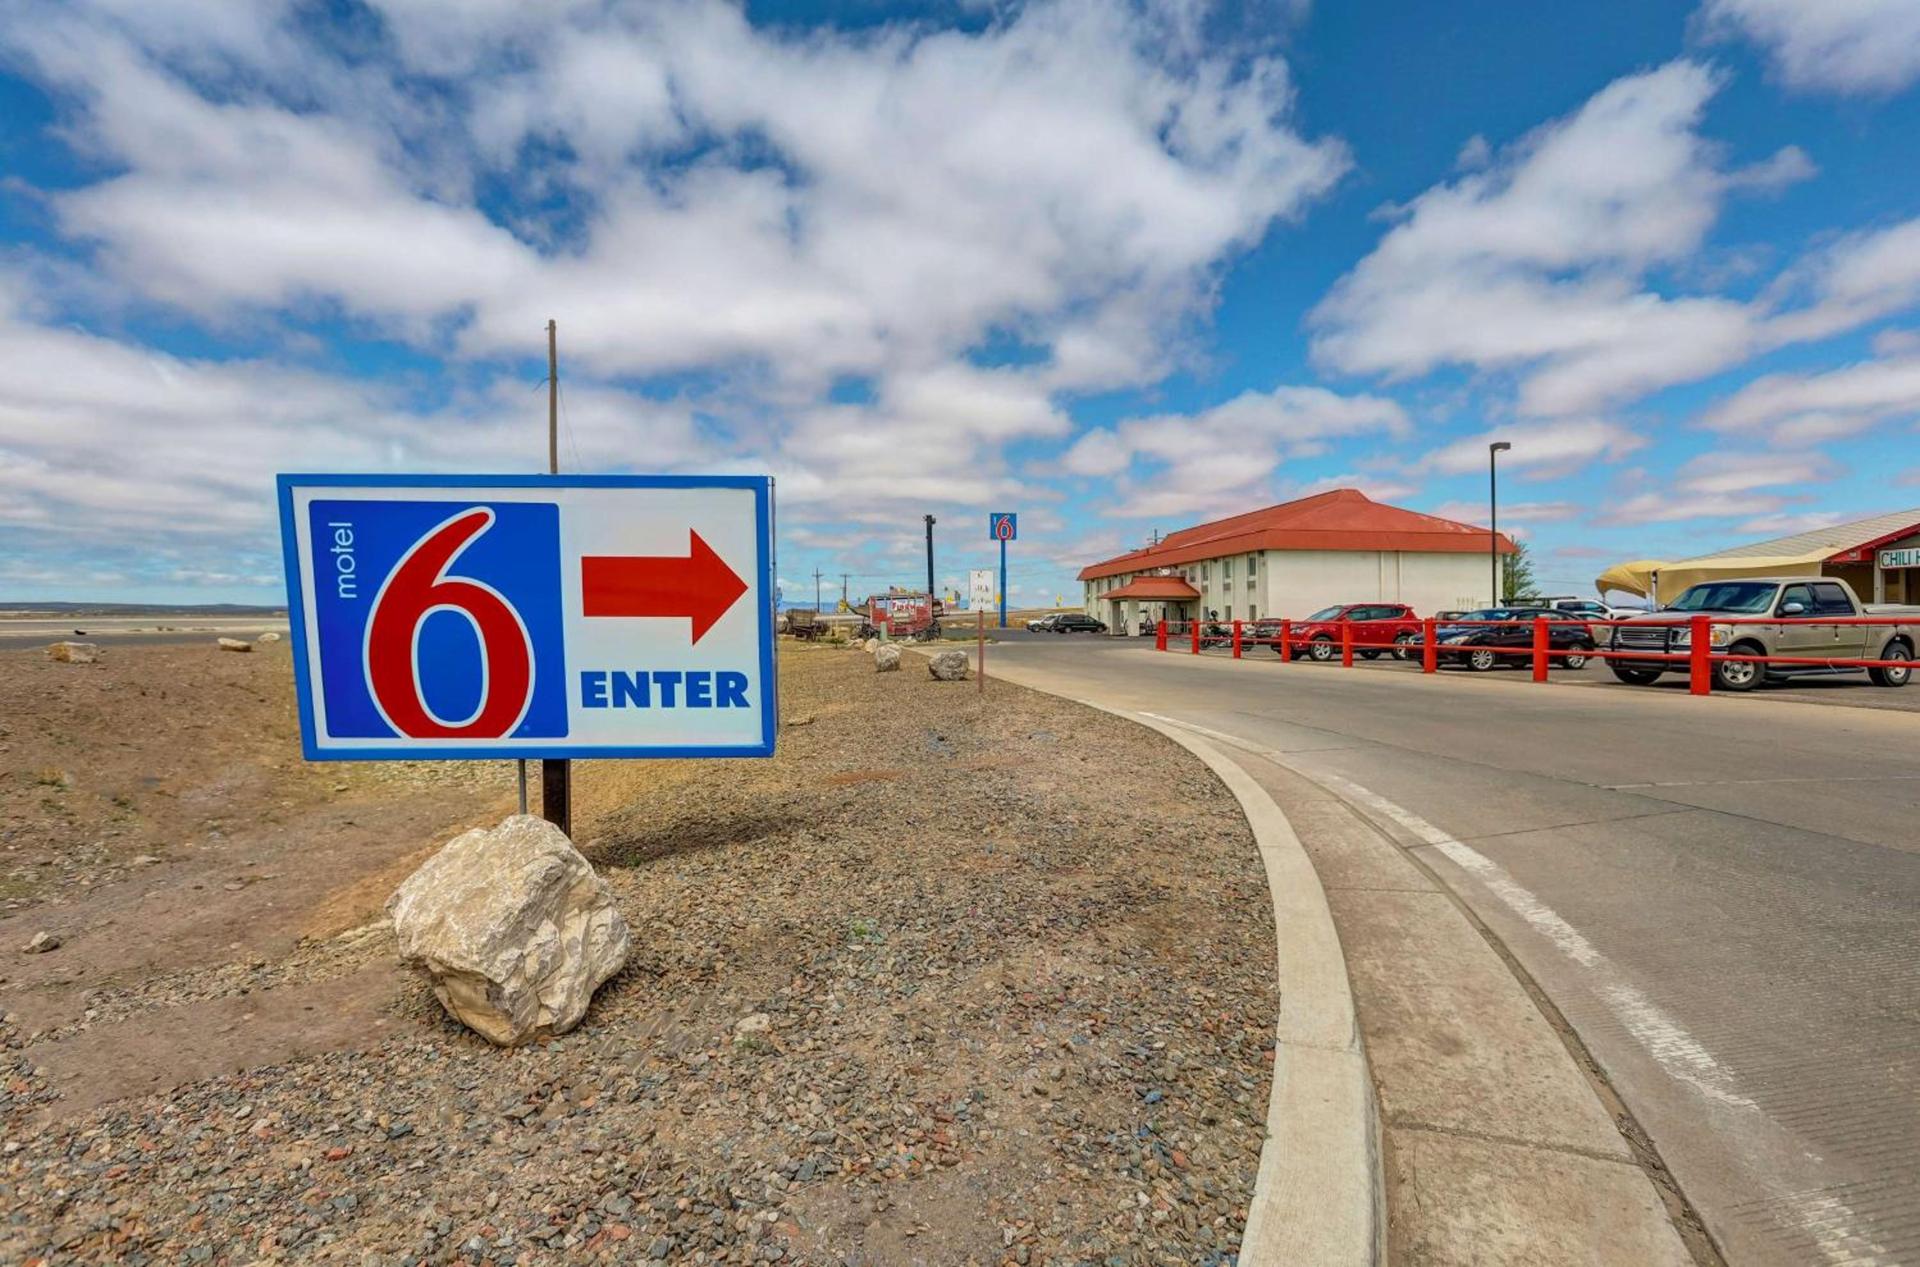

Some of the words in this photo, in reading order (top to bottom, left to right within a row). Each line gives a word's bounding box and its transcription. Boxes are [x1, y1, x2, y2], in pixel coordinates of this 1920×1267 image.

[996, 515, 1014, 540] 6
[329, 522, 358, 599] motel
[1881, 551, 1911, 567] CHILI
[363, 506, 536, 739] 6
[581, 671, 750, 709] ENTER
